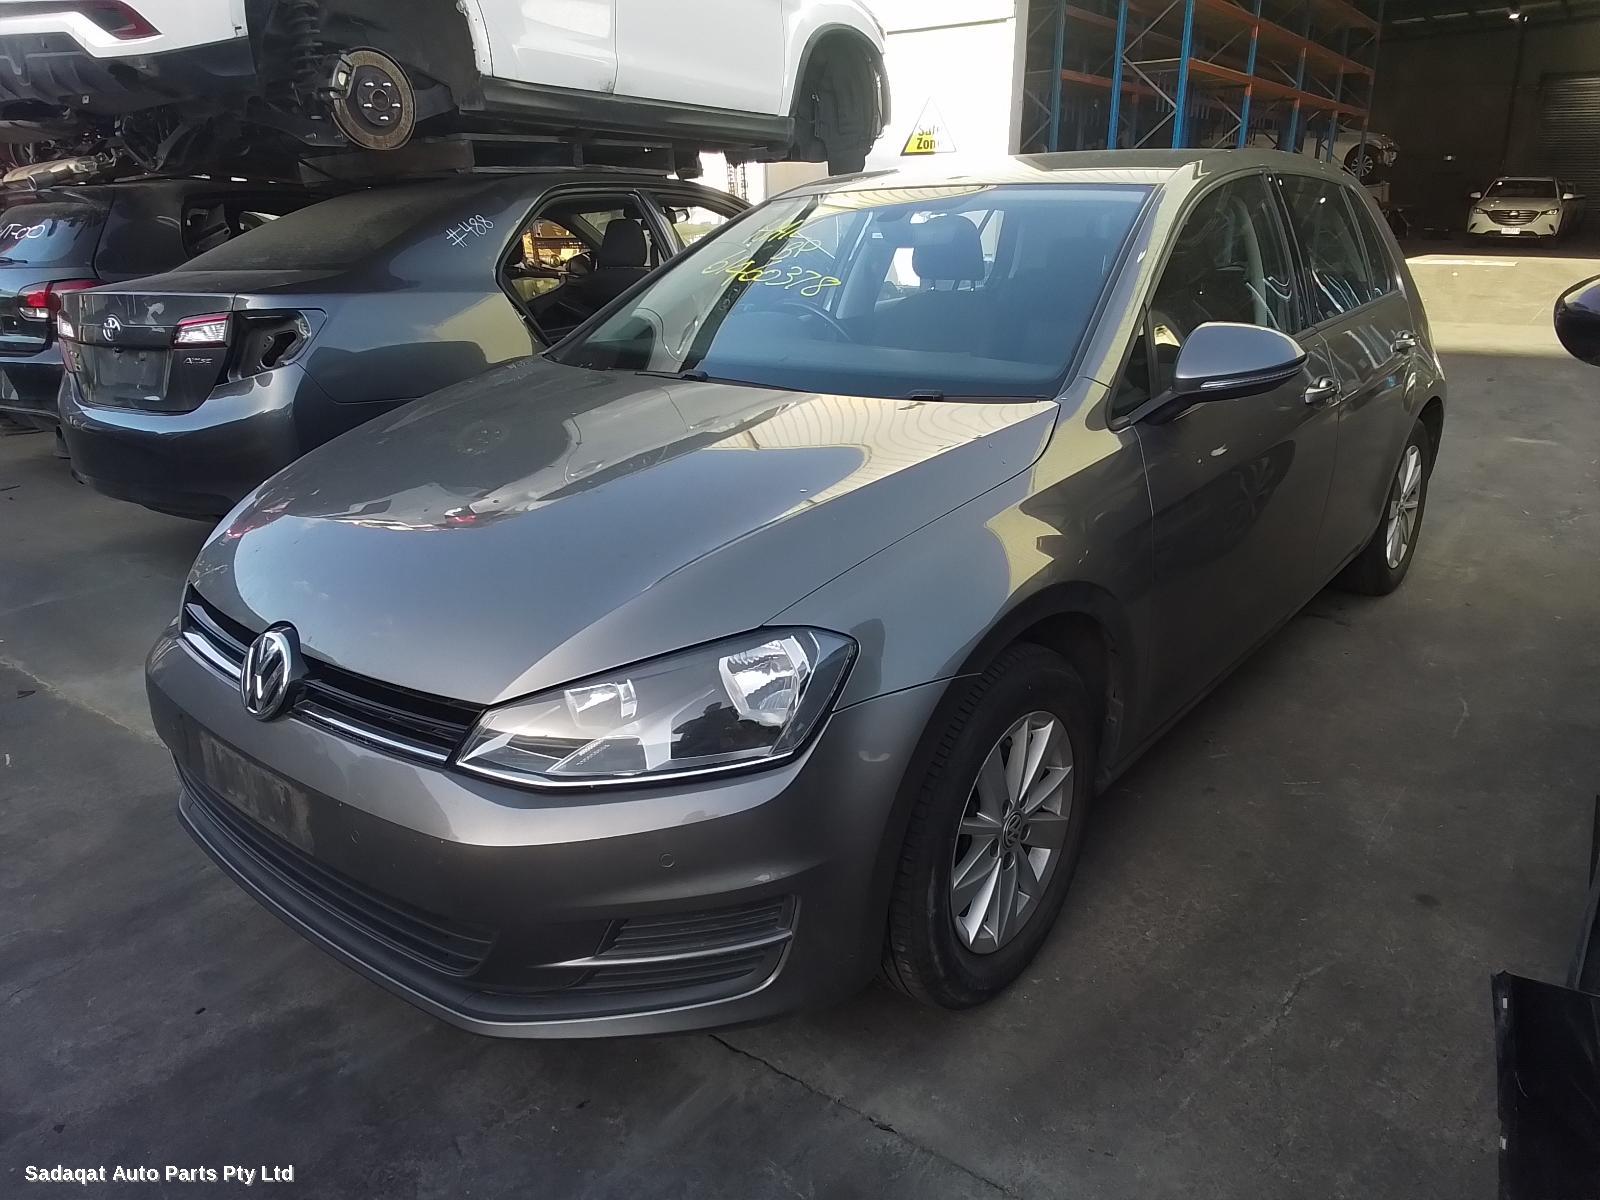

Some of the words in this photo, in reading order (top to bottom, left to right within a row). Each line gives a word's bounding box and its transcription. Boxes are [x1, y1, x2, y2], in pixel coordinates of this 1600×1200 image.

[918, 124, 940, 137] Saf
[916, 137, 940, 150] Zon
[446, 214, 494, 248] #488
